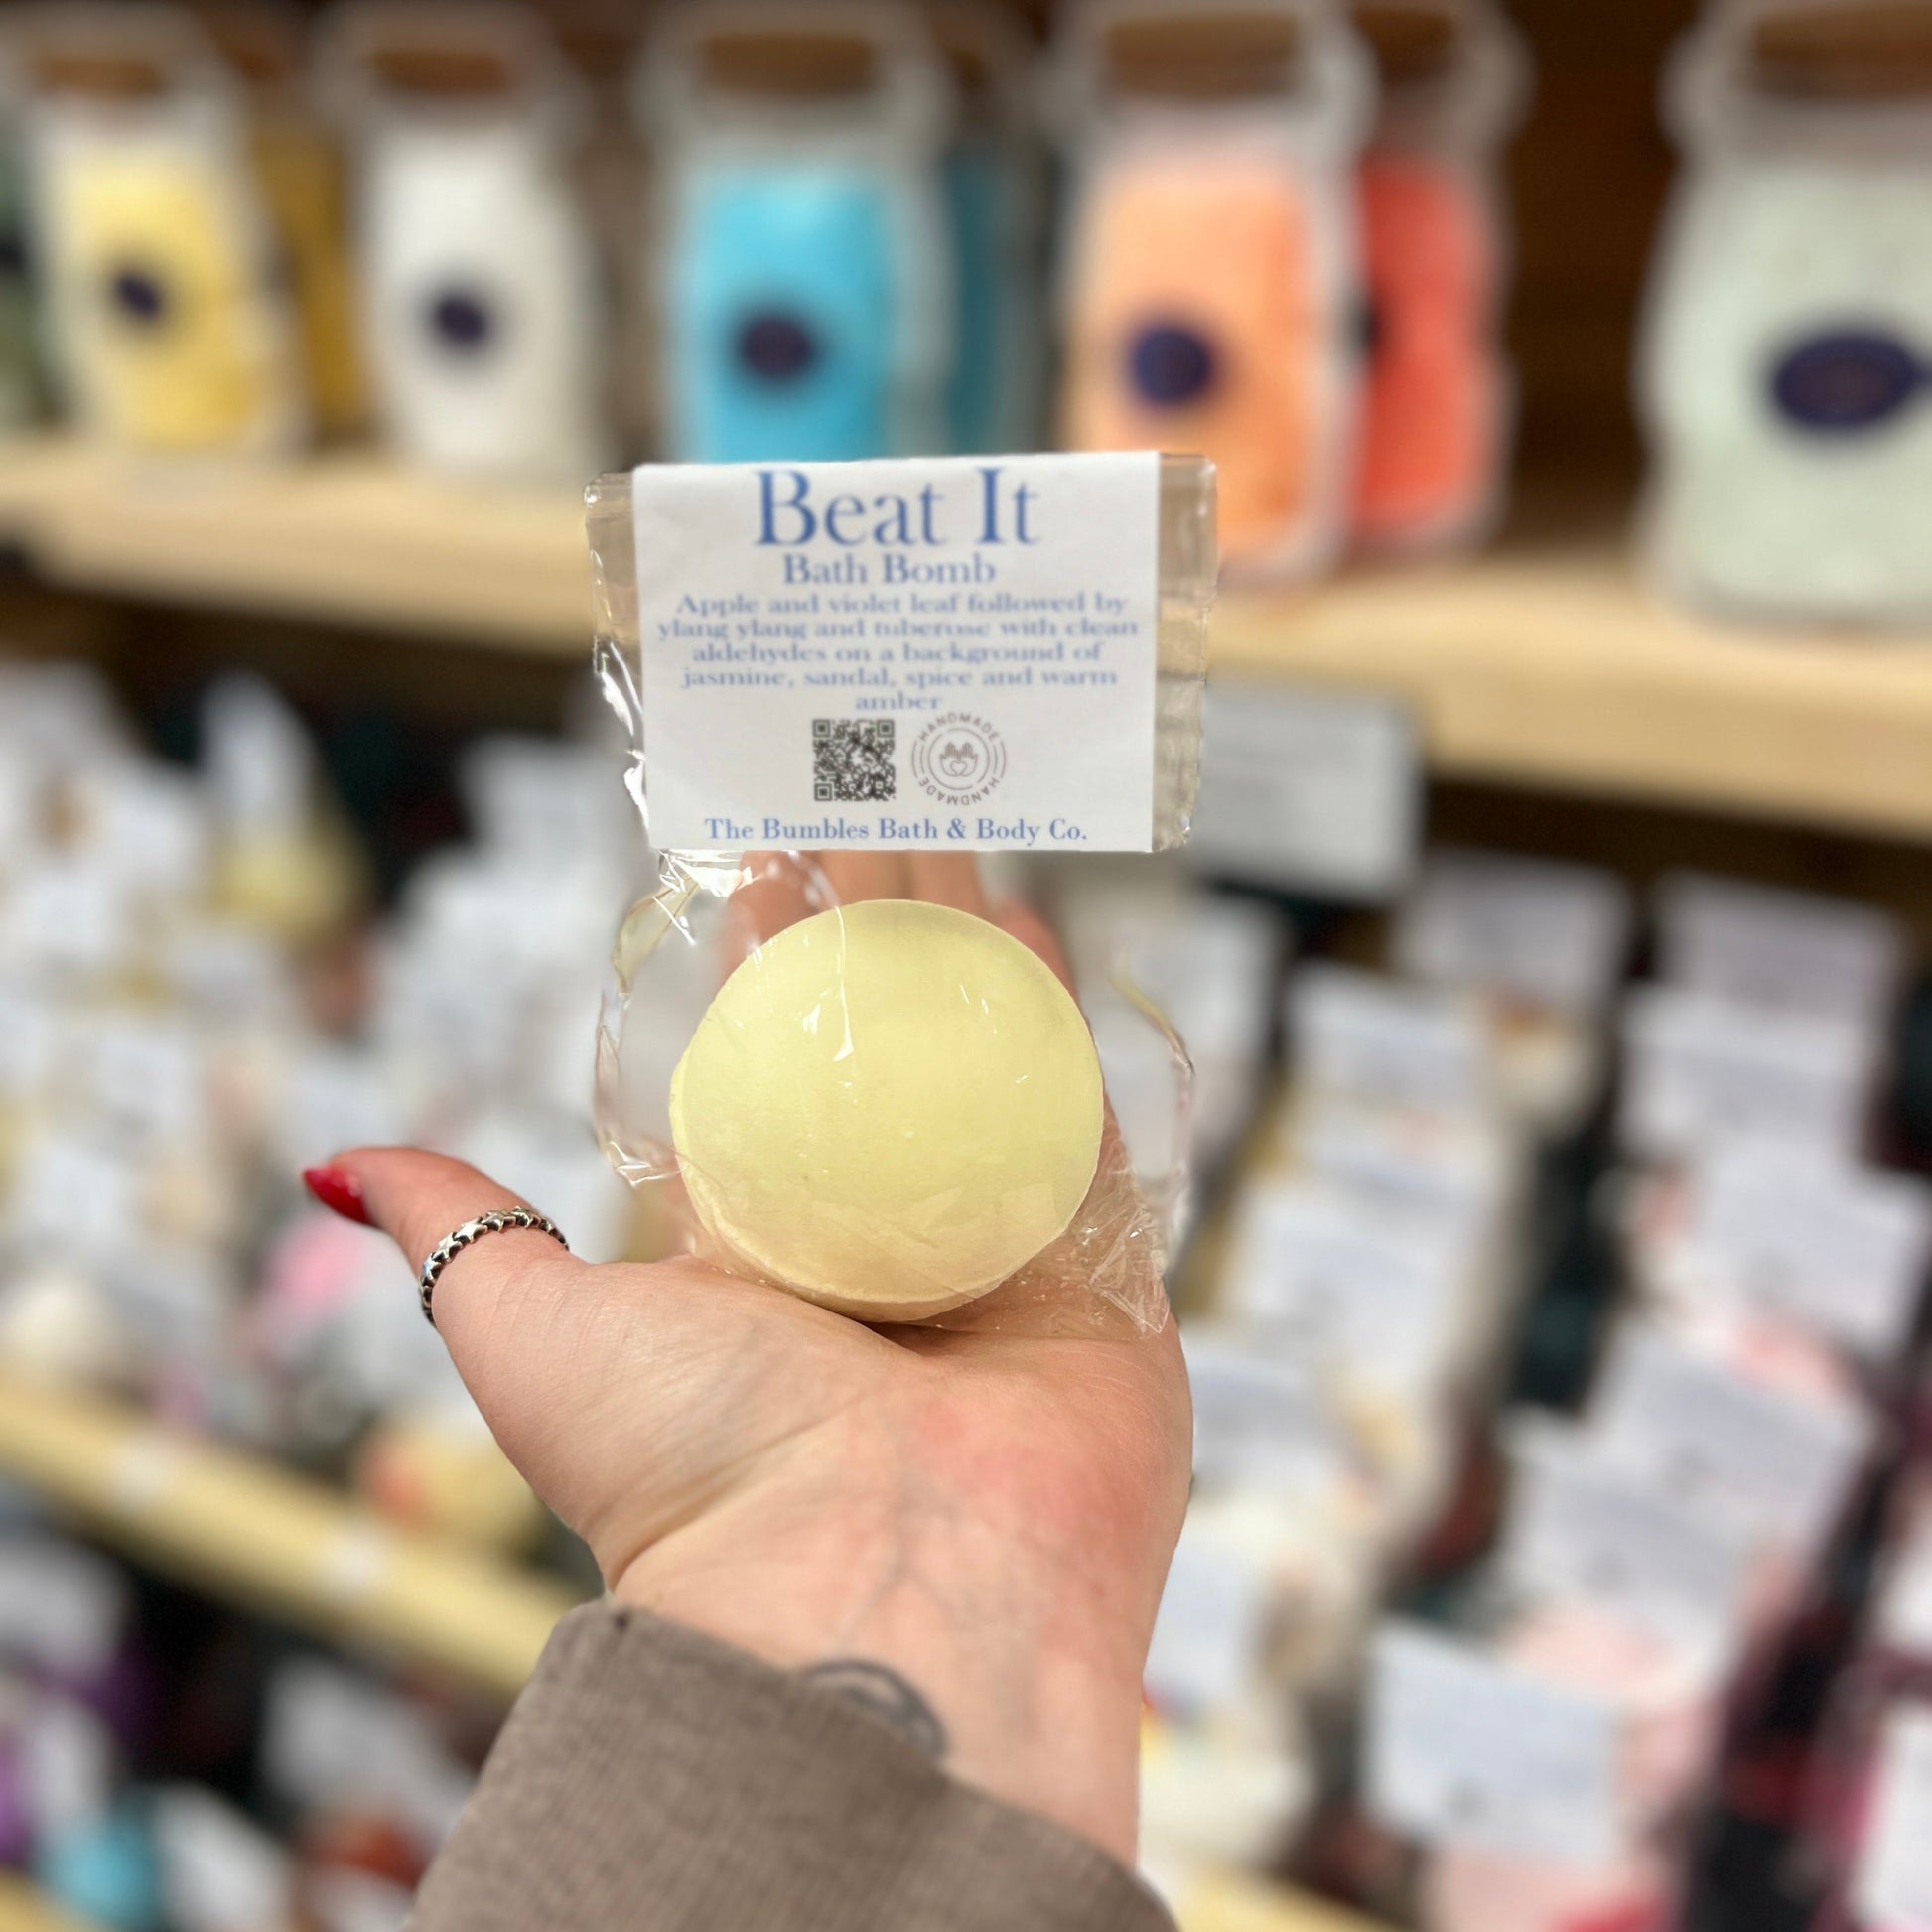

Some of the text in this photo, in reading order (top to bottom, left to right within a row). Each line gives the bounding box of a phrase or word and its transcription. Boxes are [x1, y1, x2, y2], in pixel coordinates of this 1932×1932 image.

[756, 466, 1039, 548] Beat It
[782, 551, 997, 586] Bath Bomb
[676, 592, 1127, 618] Apple and violet leaf followed by
[658, 616, 1139, 642] ylang ylang and tuberose with clean
[692, 641, 1101, 667] aldehydes on a background of
[681, 666, 1119, 692] jasmine, sandal, spice and warm
[855, 690, 942, 710] amber
[918, 712, 999, 741] HANDMADE
[918, 776, 999, 806] HANDMADE
[704, 817, 1088, 848] The Bumbles Bath & Body Co.
